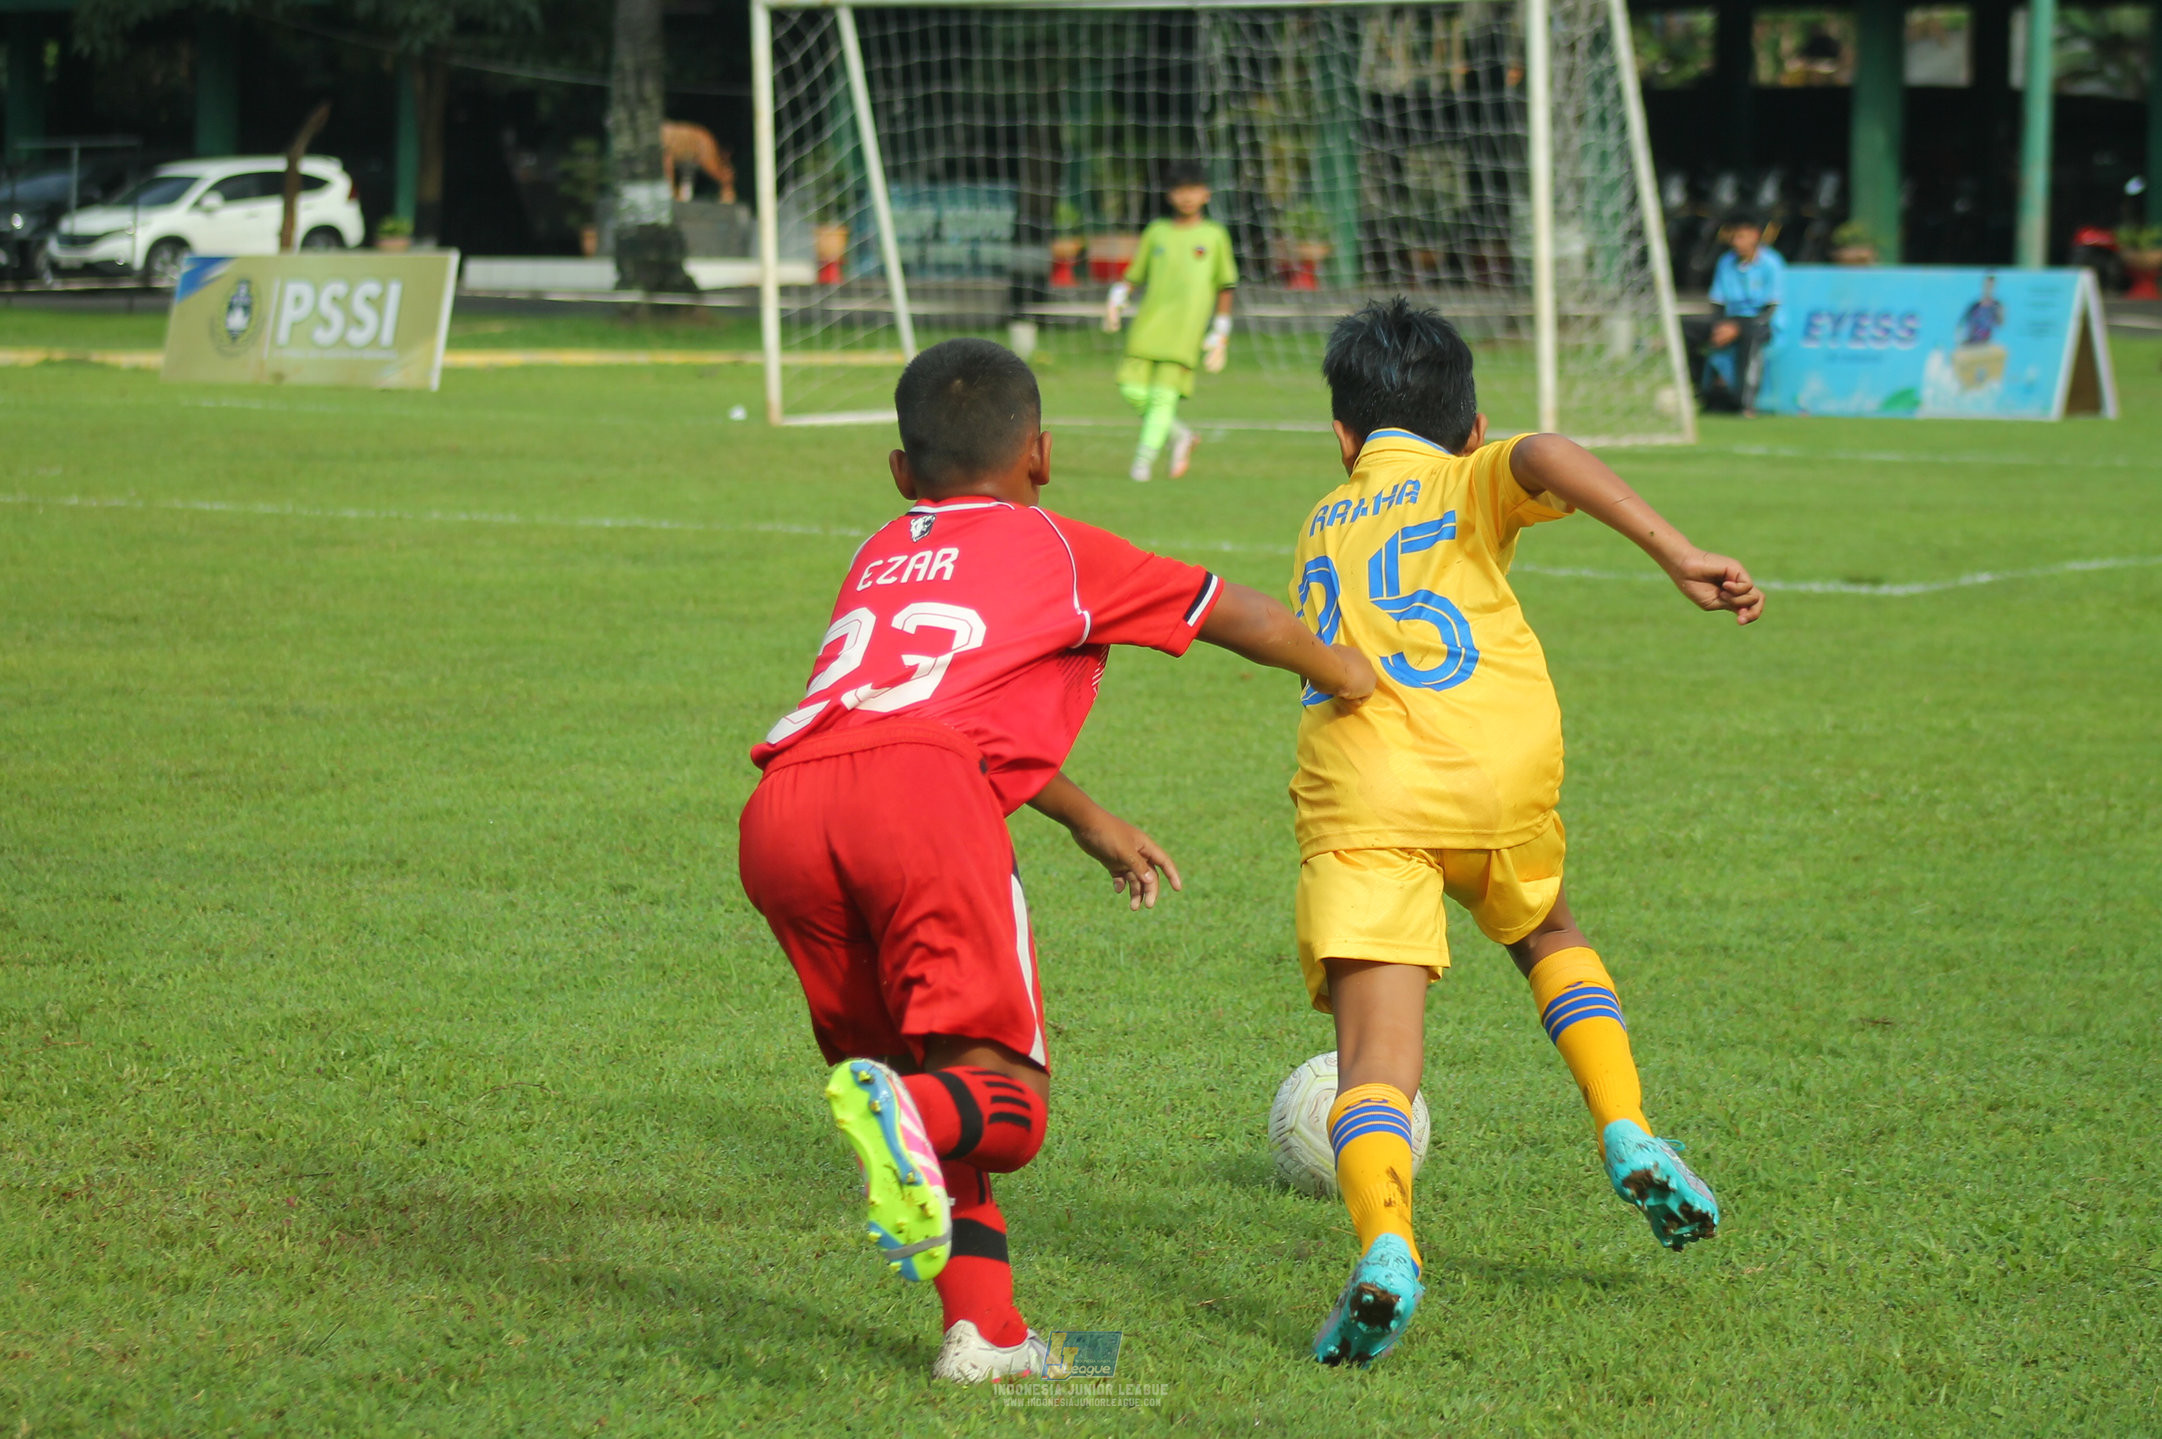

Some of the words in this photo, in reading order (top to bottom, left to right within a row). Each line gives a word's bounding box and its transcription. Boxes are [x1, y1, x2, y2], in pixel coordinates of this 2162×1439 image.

[275, 279, 402, 348] PSSI
[1799, 309, 1922, 350] EYESS
[856, 547, 959, 592] EZAR
[766, 602, 987, 745] 23
